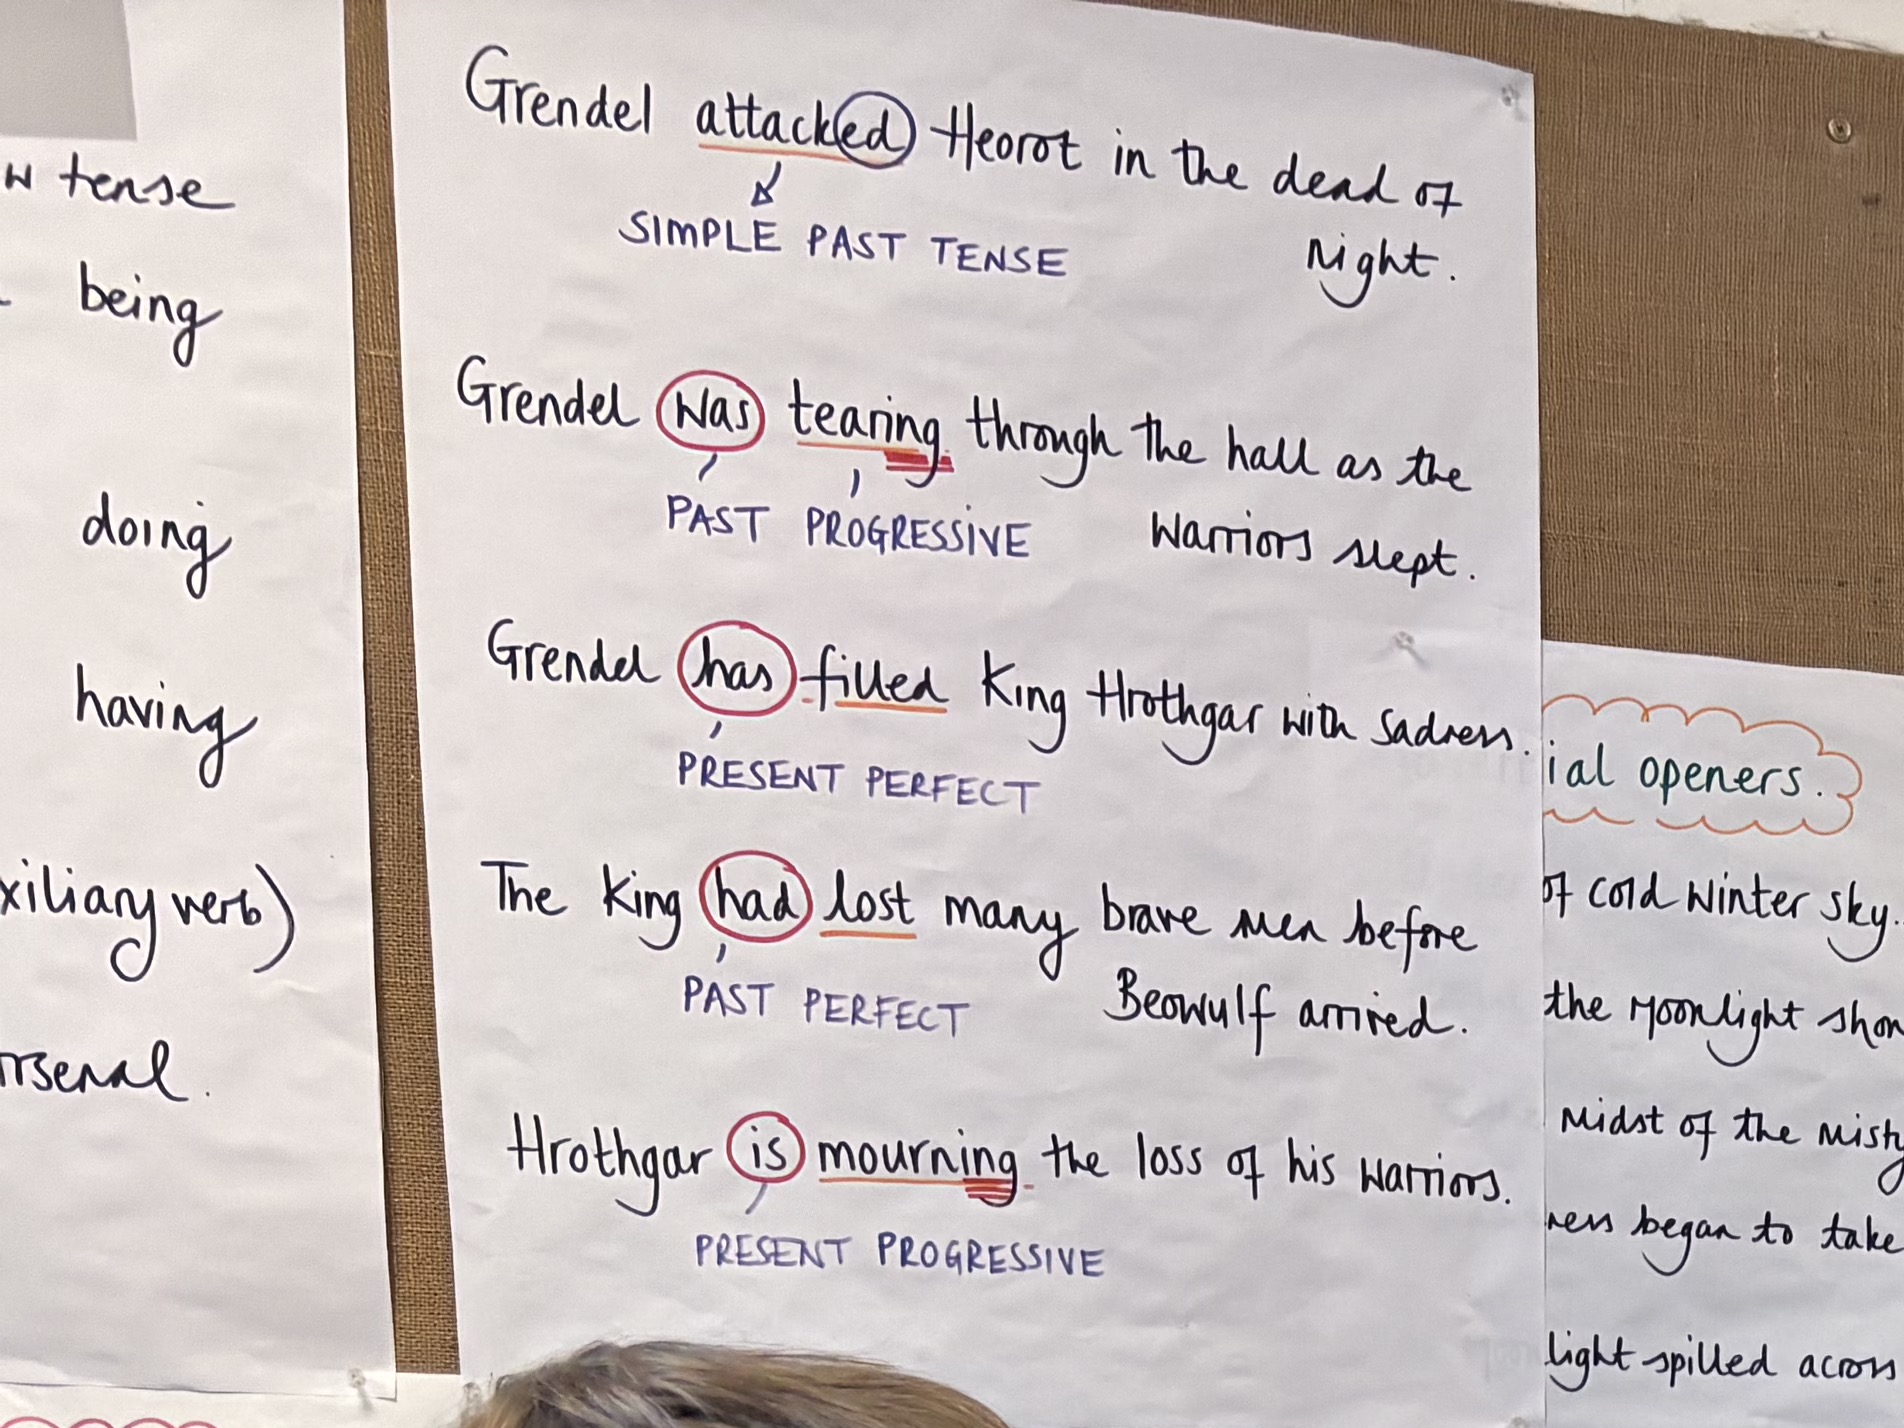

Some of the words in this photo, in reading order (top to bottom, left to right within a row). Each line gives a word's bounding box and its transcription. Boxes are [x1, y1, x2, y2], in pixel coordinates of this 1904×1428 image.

[464, 43, 652, 135] Grendel
[695, 91, 898, 155] attacked
[928, 100, 1084, 173] Heorot
[1113, 127, 1156, 180] in
[1170, 137, 1249, 192] the
[1271, 151, 1400, 205] dead
[1413, 179, 1464, 220] of
[57, 150, 237, 211] tense
[617, 208, 783, 254] SIMPLE
[806, 222, 908, 262] PAST
[929, 235, 1070, 278] TENSE
[78, 259, 224, 369] being
[455, 353, 642, 429] Grendel
[787, 376, 946, 492] tearing
[964, 394, 1124, 490] through
[1129, 413, 1208, 466] the
[1226, 422, 1321, 477] hall
[1395, 444, 1473, 494] the
[81, 490, 234, 601] doing
[665, 495, 772, 544] PAST
[805, 503, 1032, 559] PROGRESSIVE
[75, 661, 260, 790] having
[486, 617, 662, 685] Grendel
[691, 641, 774, 693] has
[799, 644, 951, 711] filled
[980, 648, 1068, 756] King
[1084, 667, 1265, 767] Hrothgar
[1281, 701, 1358, 742] with
[677, 749, 846, 794] PRESENT
[865, 764, 1042, 815] PERFECT
[1638, 755, 1824, 807] openers.
[479, 859, 569, 918] The
[713, 868, 801, 923] had
[822, 867, 916, 926] lost
[943, 893, 1081, 983] many
[1100, 880, 1213, 937] brave
[1341, 897, 1479, 975] before
[683, 975, 776, 1018] PAST
[802, 985, 972, 1039] PERFECT
[1102, 965, 1278, 1058] Beowulf
[505, 1111, 714, 1219] Hrothgar
[816, 1138, 1019, 1209] mourning
[1040, 1132, 1110, 1180] the
[1135, 1130, 1203, 1181] loss
[1286, 1135, 1336, 1187] his
[1732, 1105, 1802, 1146] the
[694, 1231, 853, 1271] PRESENT
[876, 1231, 1105, 1279] PROGRESSIVE
[1629, 1204, 1742, 1278] began
